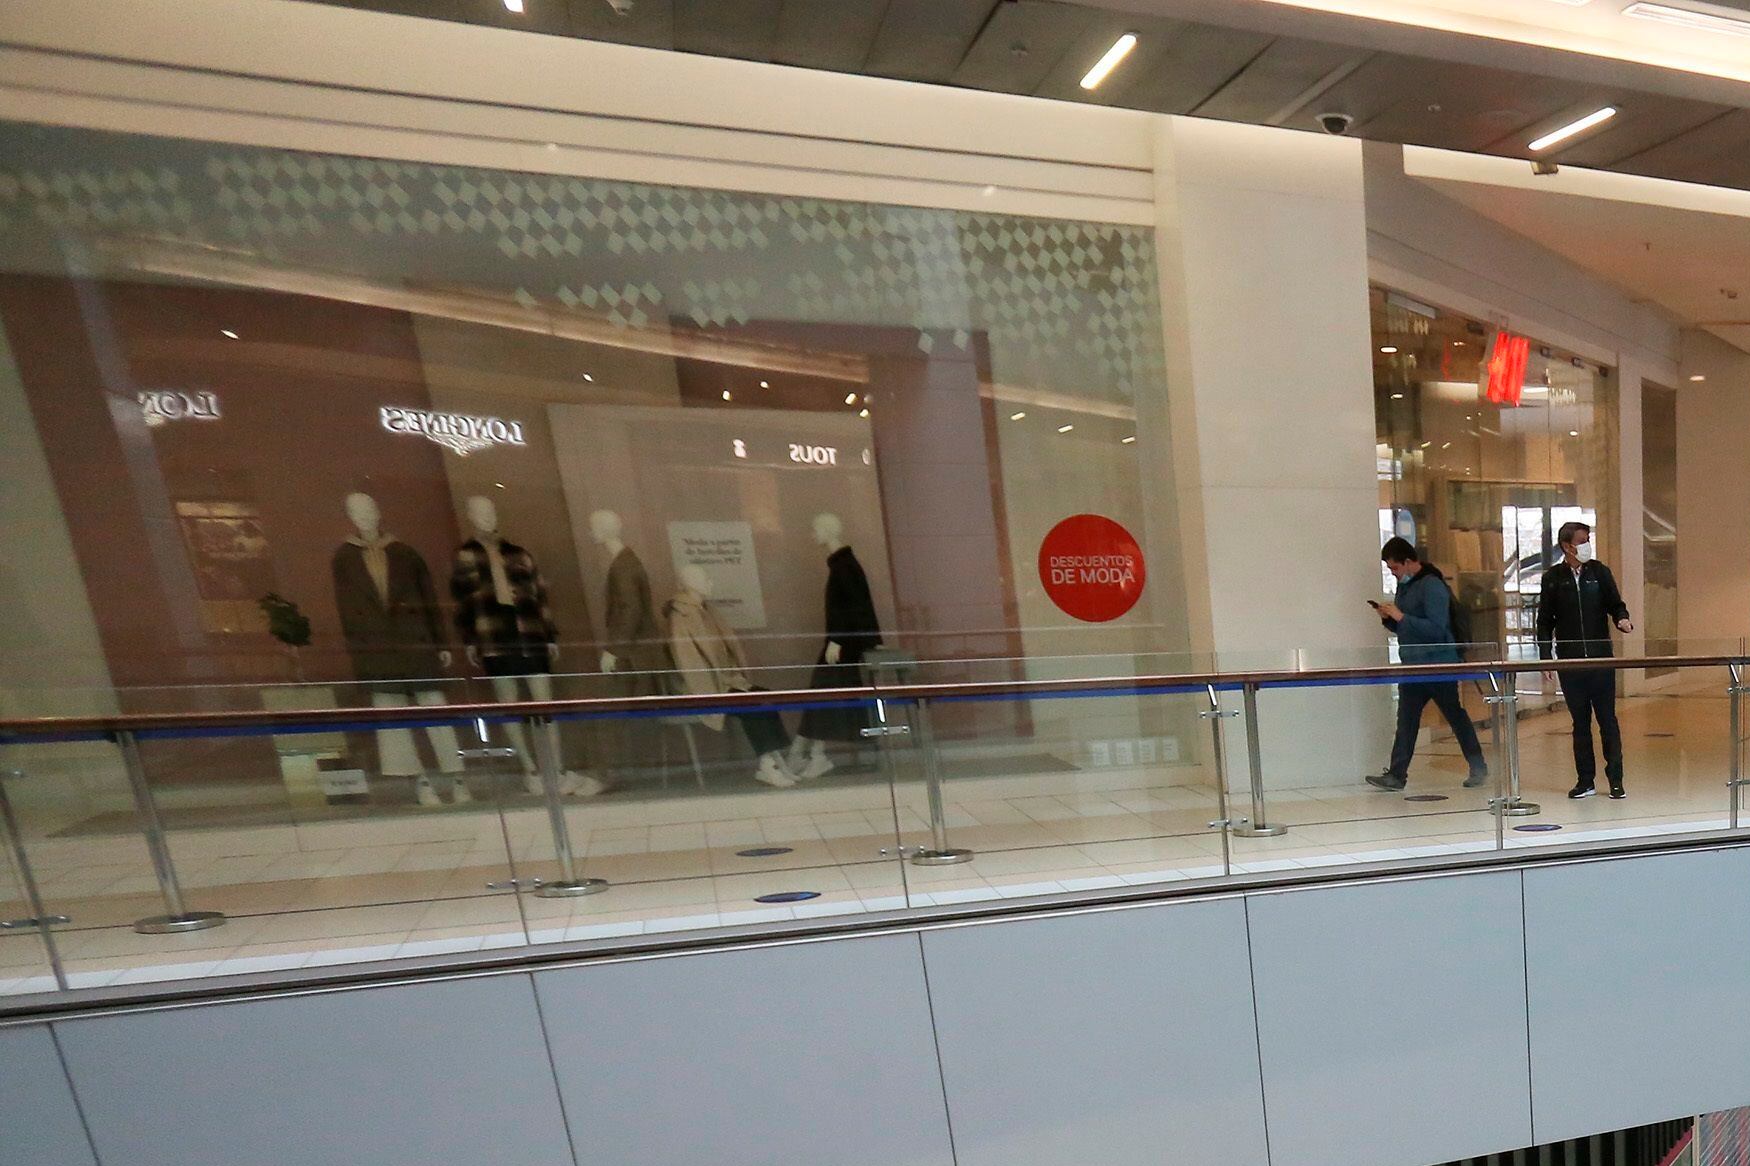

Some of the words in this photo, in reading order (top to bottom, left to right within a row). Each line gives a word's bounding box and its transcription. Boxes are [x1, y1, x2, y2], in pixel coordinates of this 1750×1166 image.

[1050, 555, 1134, 568] DESCUENTOS
[1051, 568, 1076, 584] DE
[1080, 567, 1135, 584] MODA
